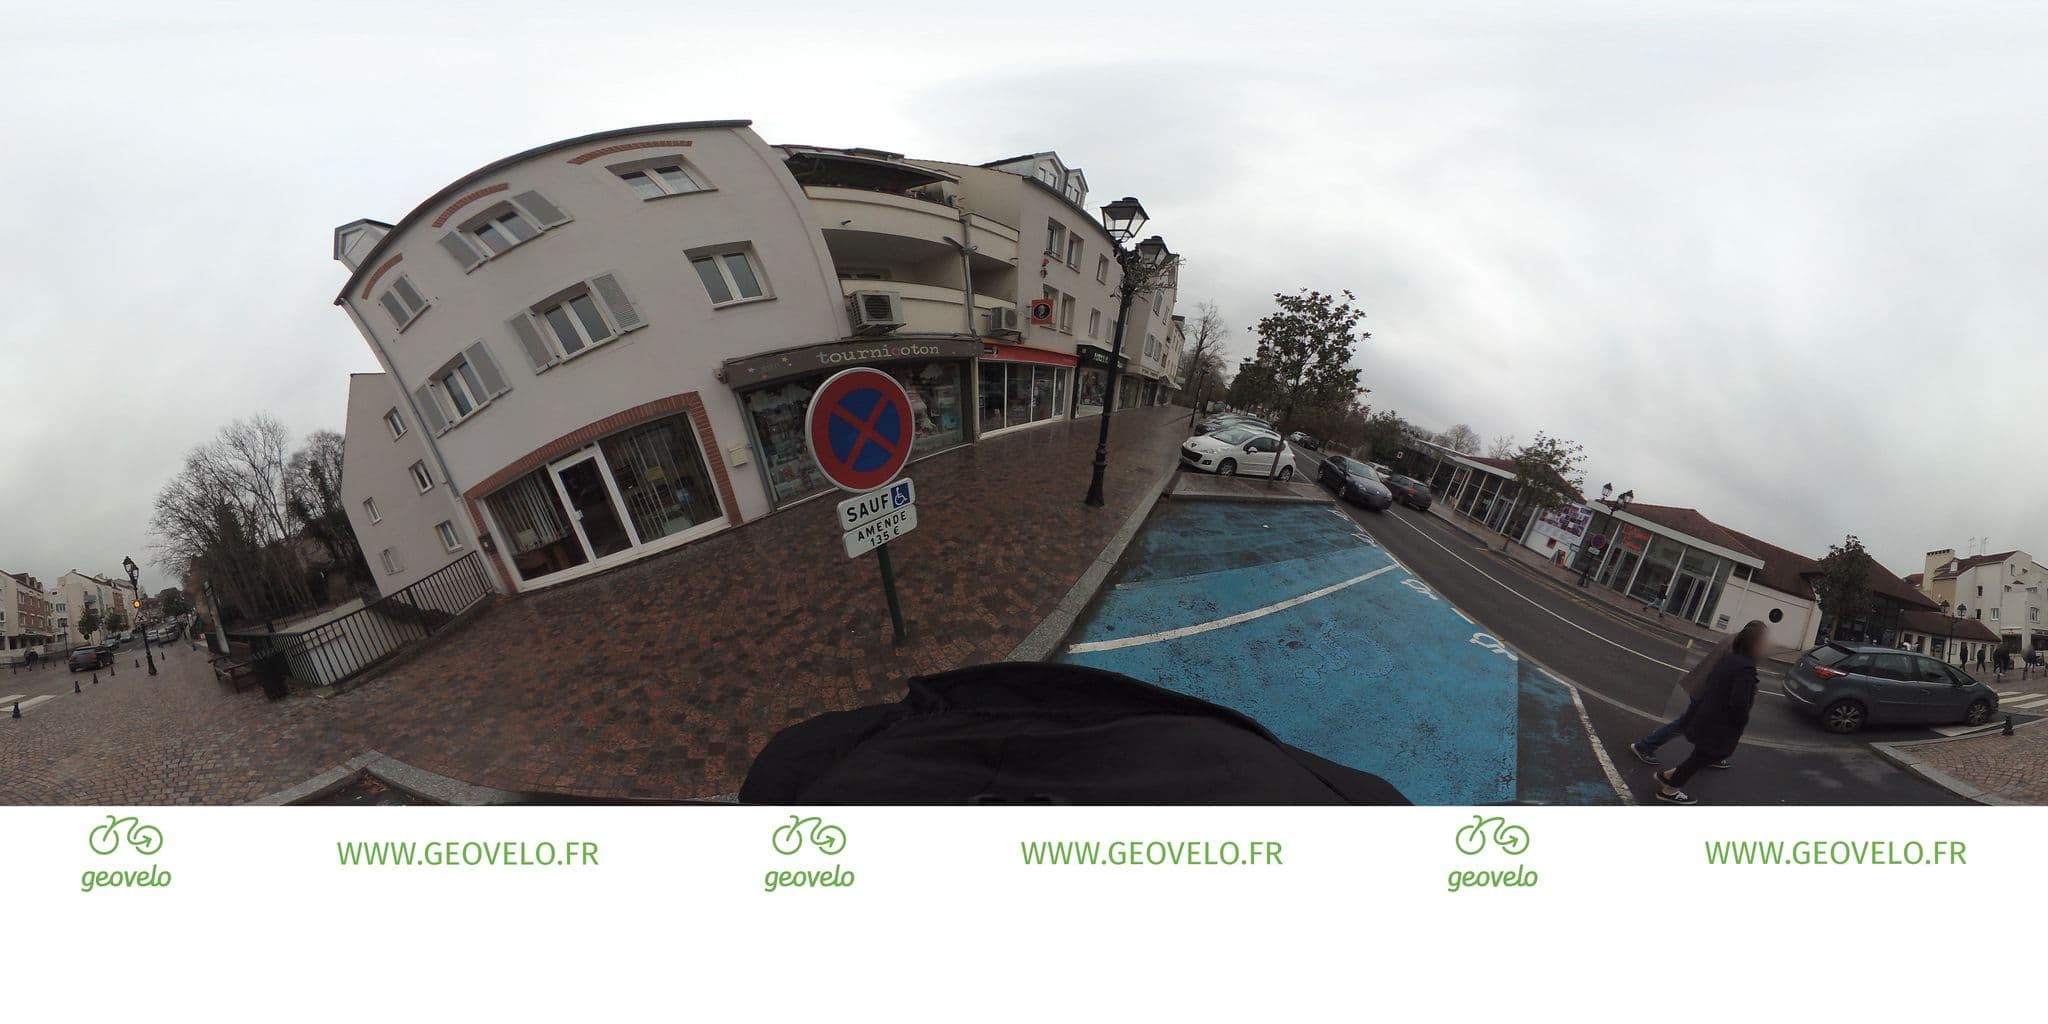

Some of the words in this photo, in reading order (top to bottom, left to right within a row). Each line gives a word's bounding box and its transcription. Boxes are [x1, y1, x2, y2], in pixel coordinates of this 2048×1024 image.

[815, 343, 940, 365] tournicoton
[847, 493, 889, 523] SAUF
[857, 510, 907, 542] AMENDE
[870, 530, 890, 547] 135
[893, 525, 901, 536] €
